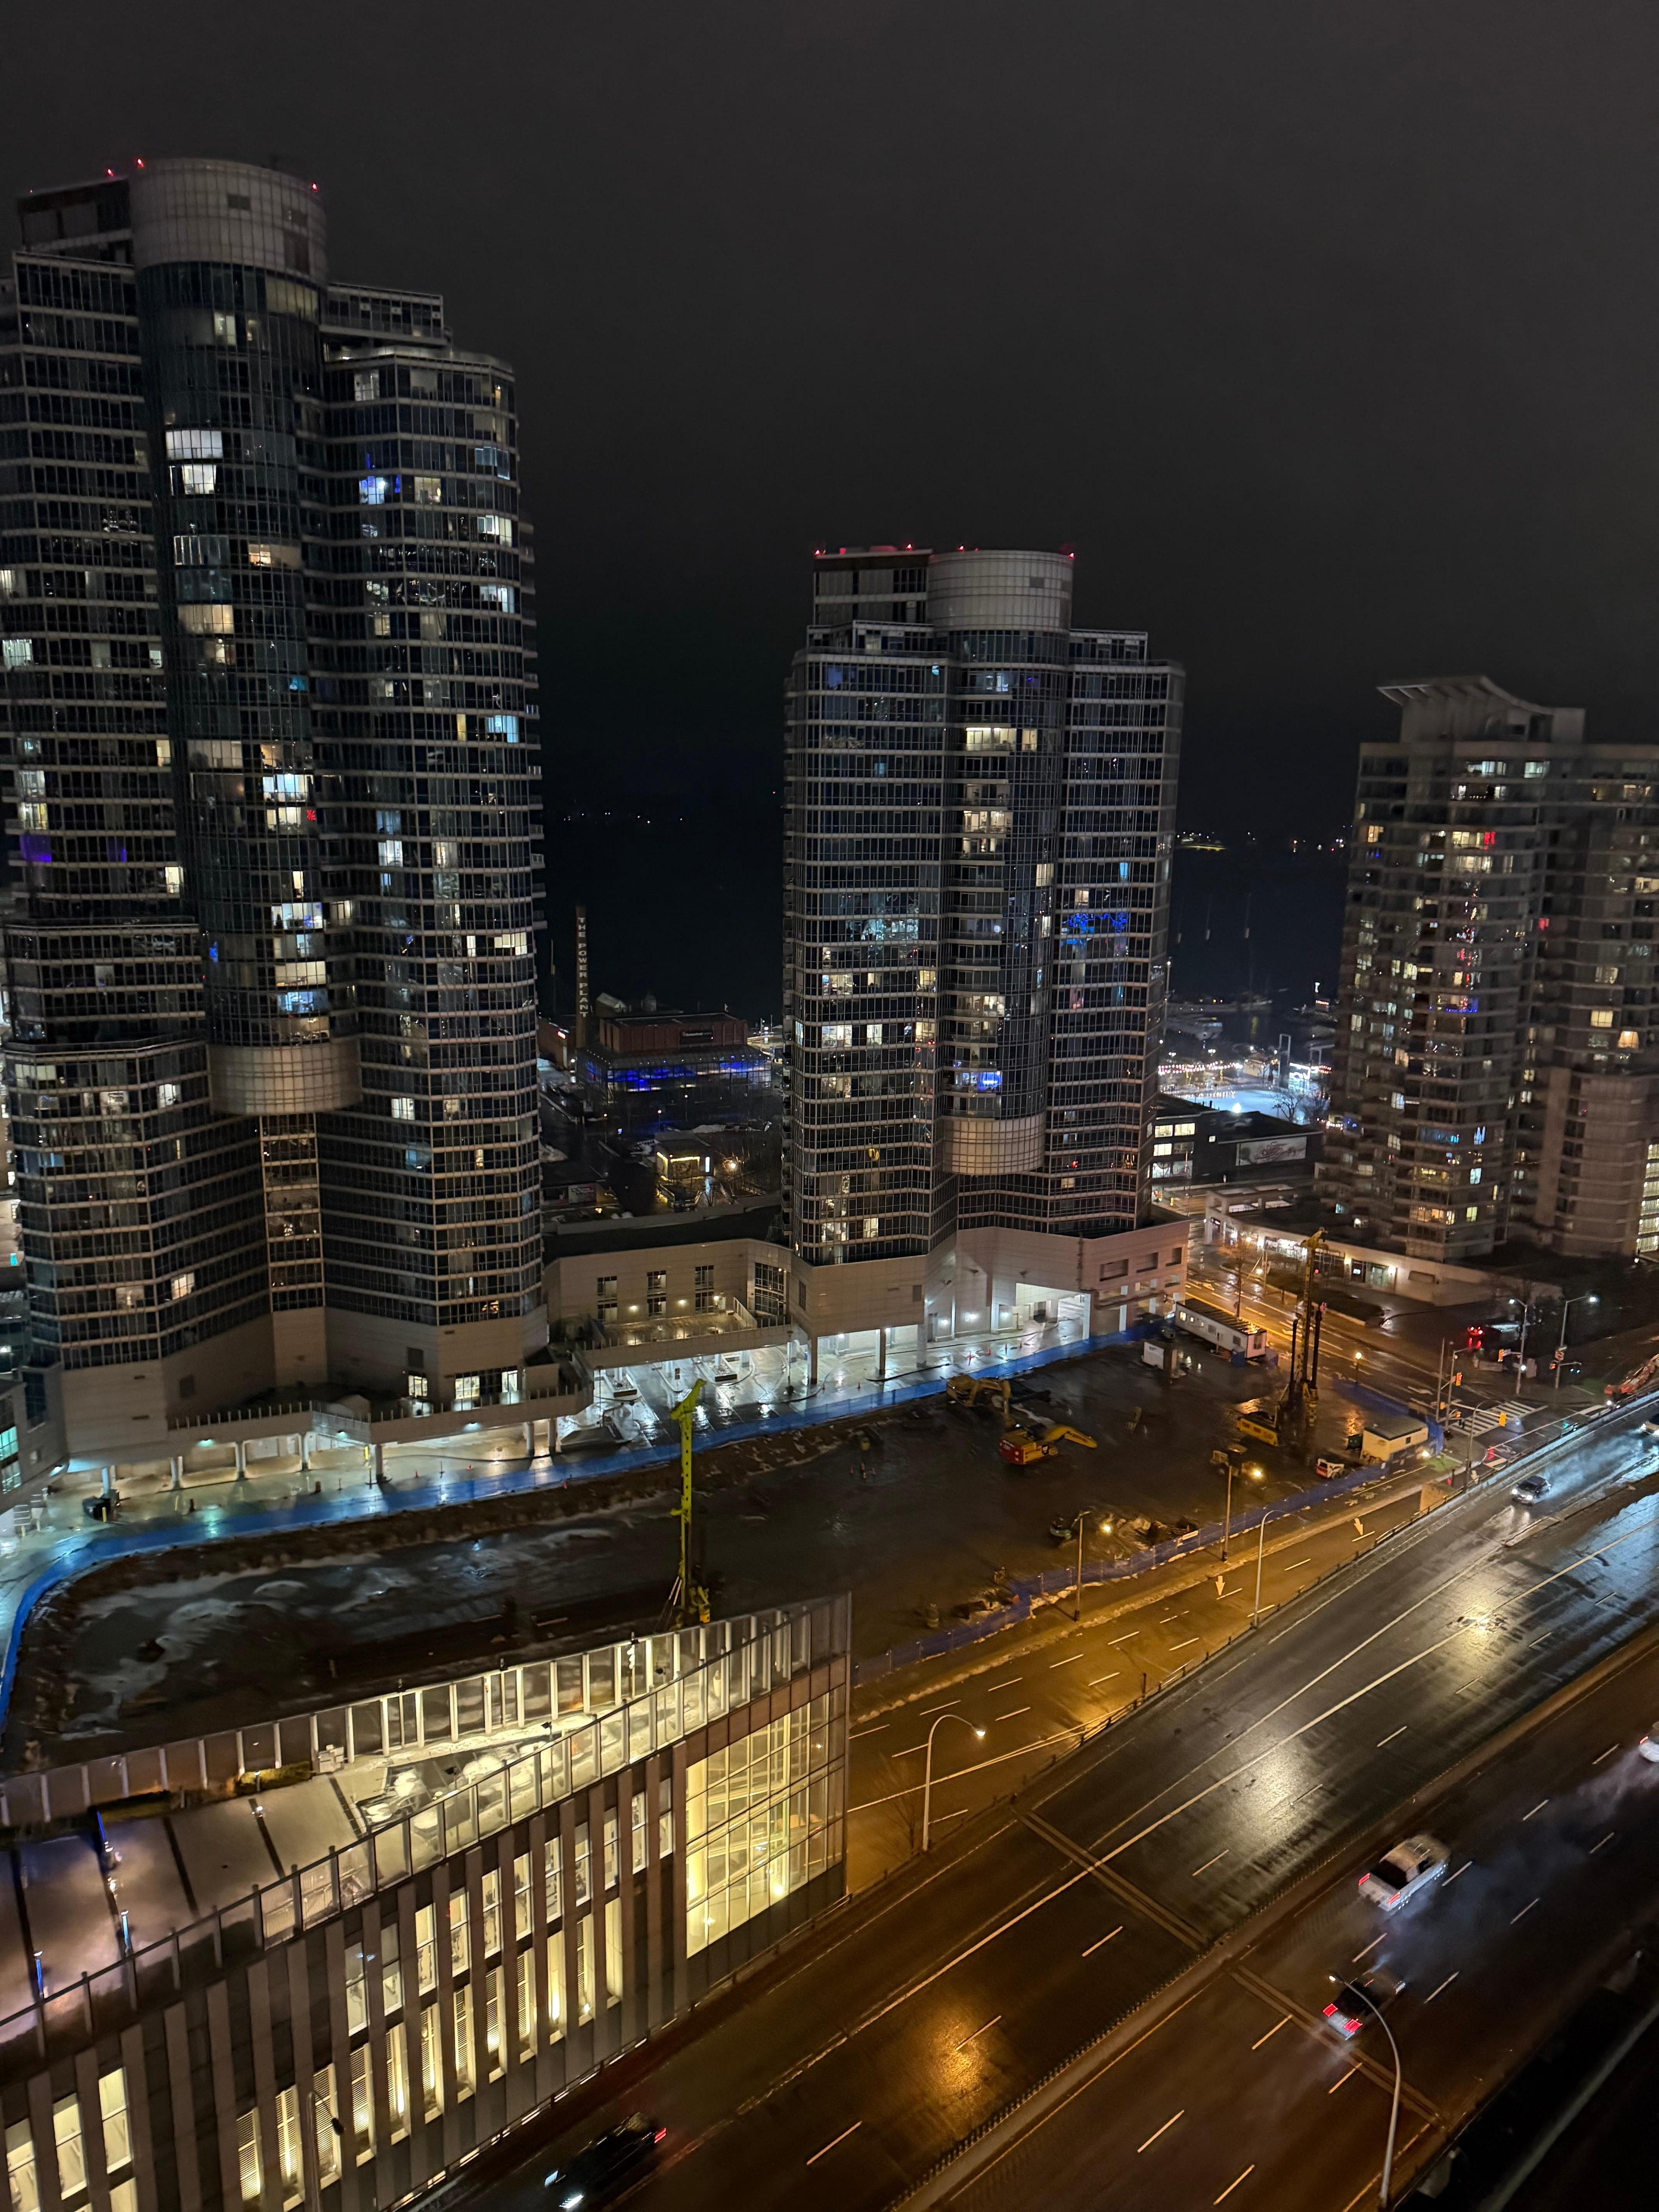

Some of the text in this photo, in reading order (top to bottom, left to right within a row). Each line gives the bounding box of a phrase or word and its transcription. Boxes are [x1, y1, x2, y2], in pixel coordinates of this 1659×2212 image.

[577, 917, 588, 1017] THE POWER PLANT
